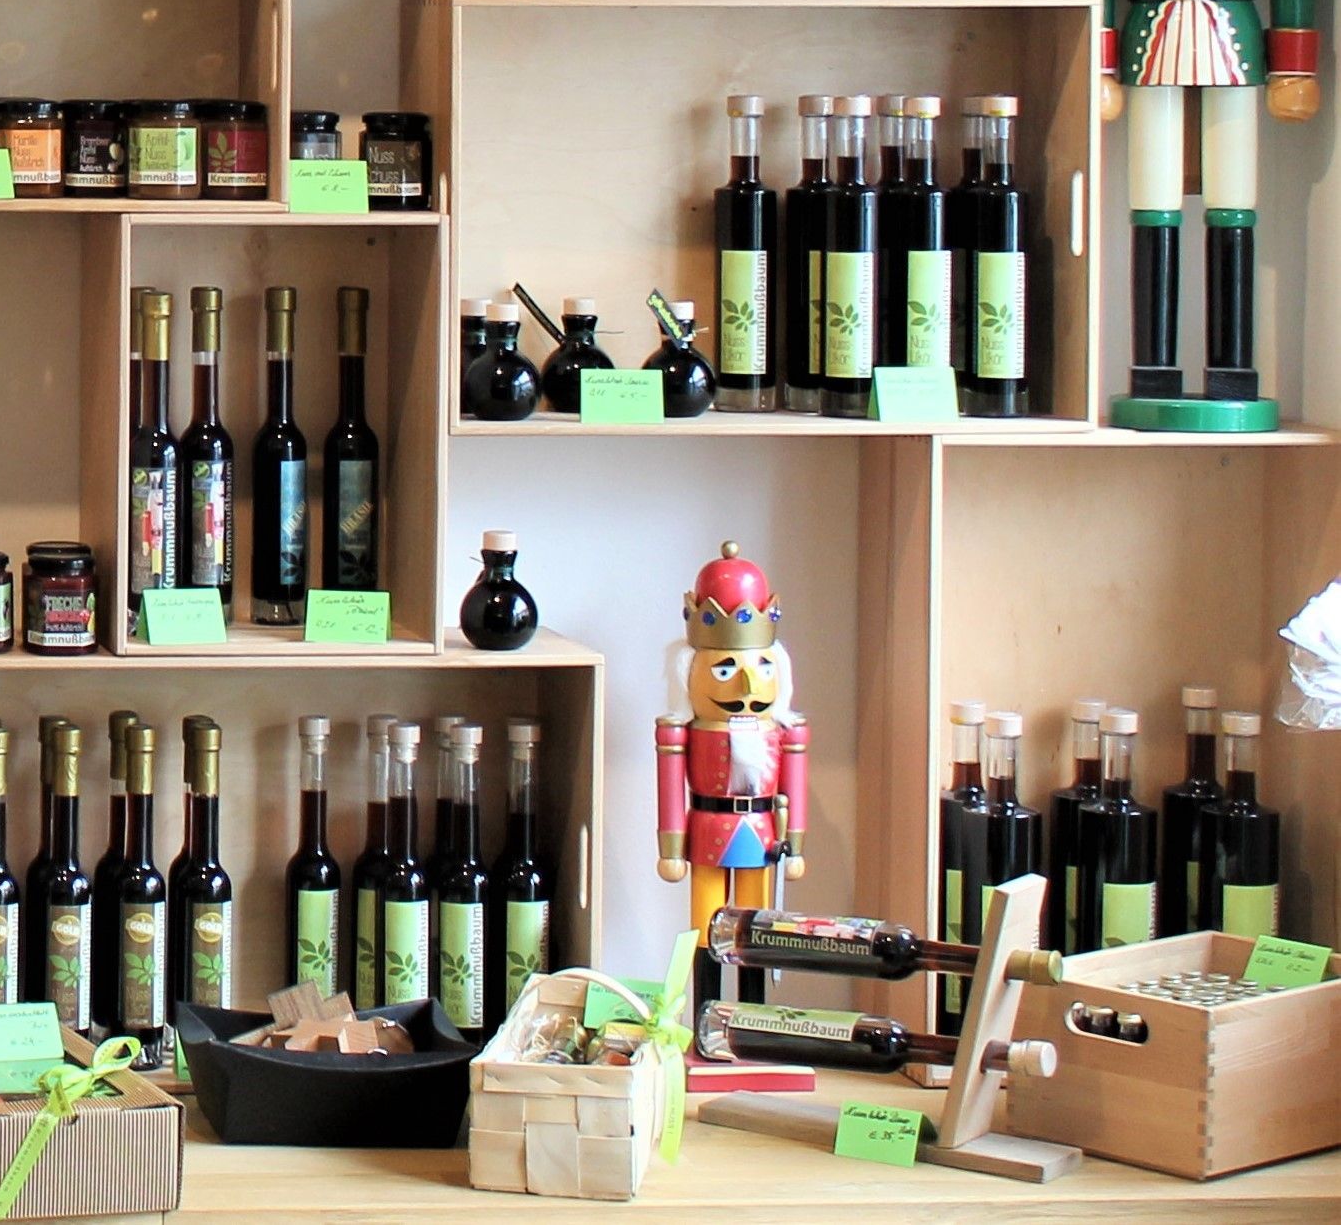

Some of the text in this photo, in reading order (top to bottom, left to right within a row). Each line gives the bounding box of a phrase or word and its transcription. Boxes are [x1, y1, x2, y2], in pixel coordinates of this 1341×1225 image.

[369, 147, 395, 165] Nuss
[751, 929, 870, 956] Krummnußbaum
[470, 904, 483, 1026] Krummnußbaum
[731, 1012, 851, 1039] Krummnußbaum
